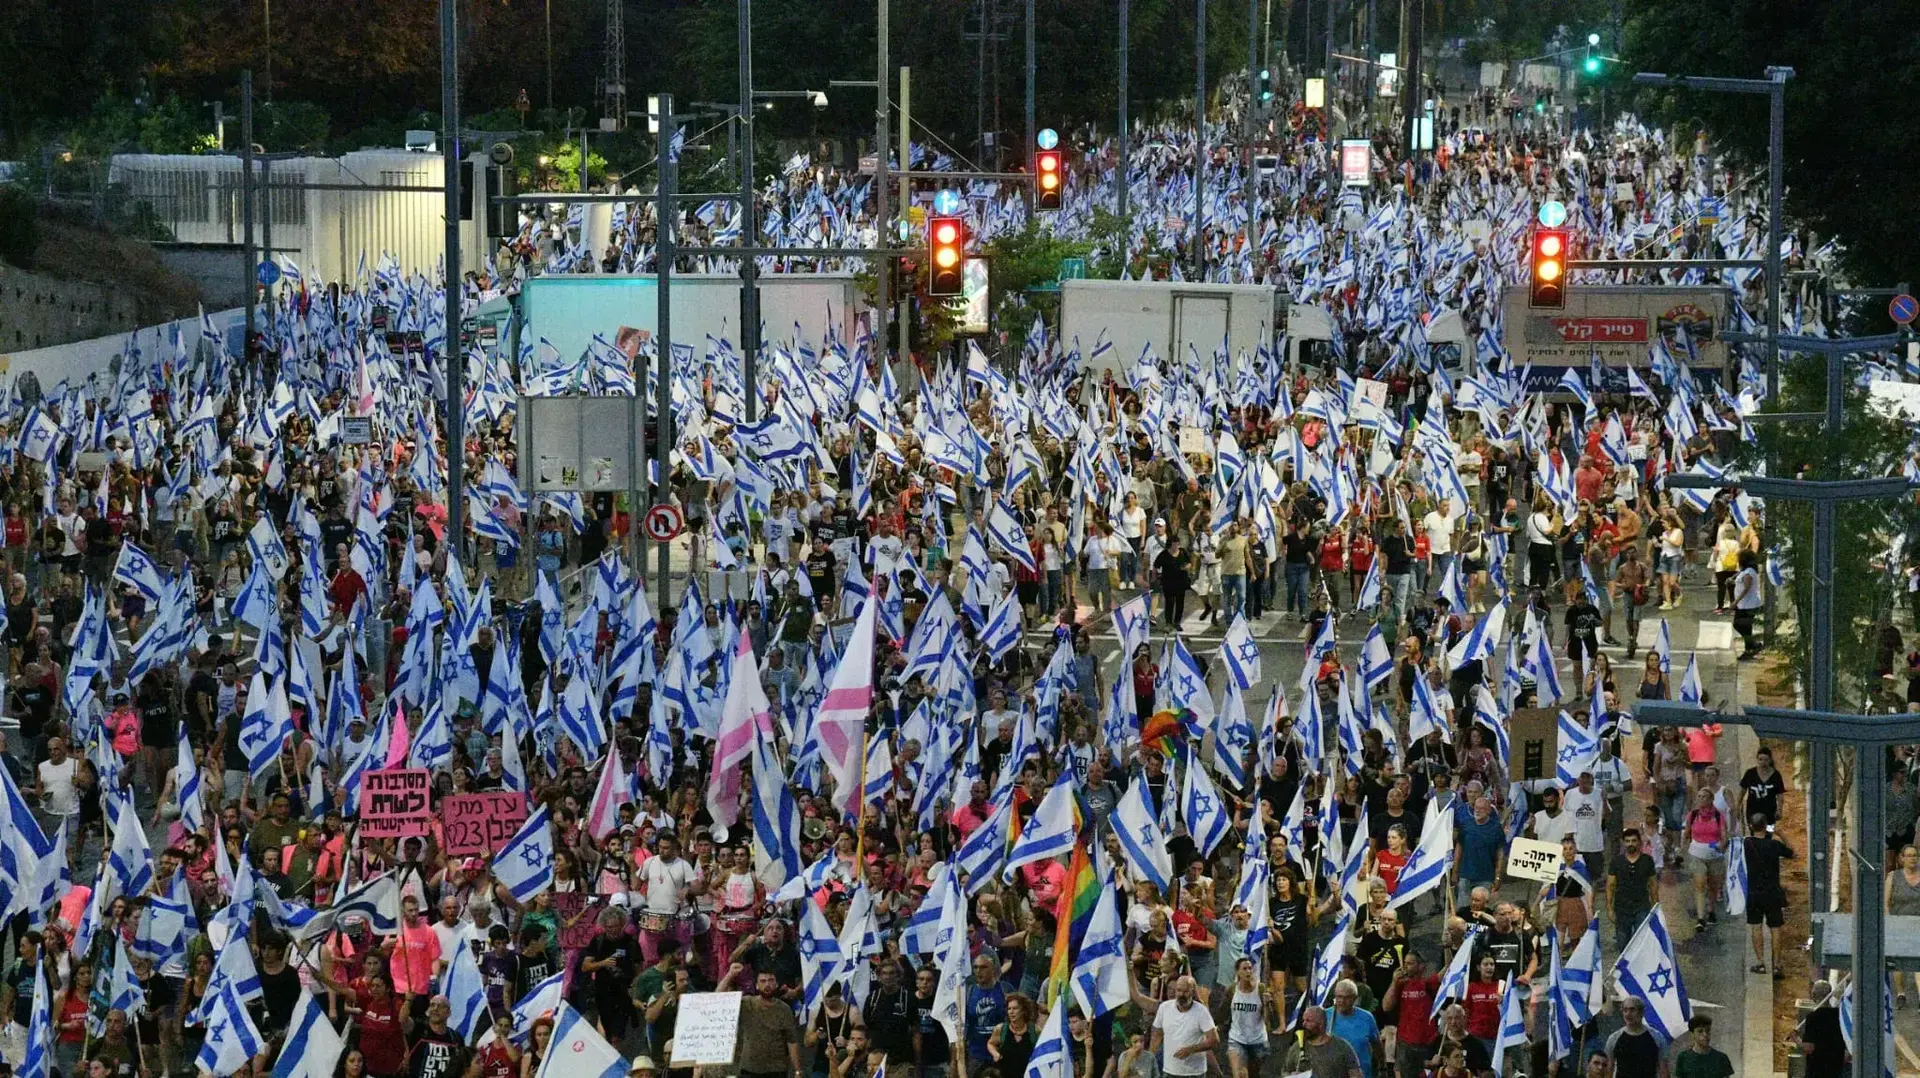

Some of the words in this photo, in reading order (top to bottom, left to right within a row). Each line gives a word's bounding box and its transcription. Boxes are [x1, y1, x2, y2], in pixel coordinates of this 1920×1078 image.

[1557, 321, 1593, 339] קלא
[1600, 324, 1635, 336] טייר
[366, 772, 427, 790] מסרבות
[369, 790, 425, 814] לשרת
[452, 799, 483, 817] מתי
[487, 797, 517, 814] עד
[1512, 858, 1542, 872] קרטיה
